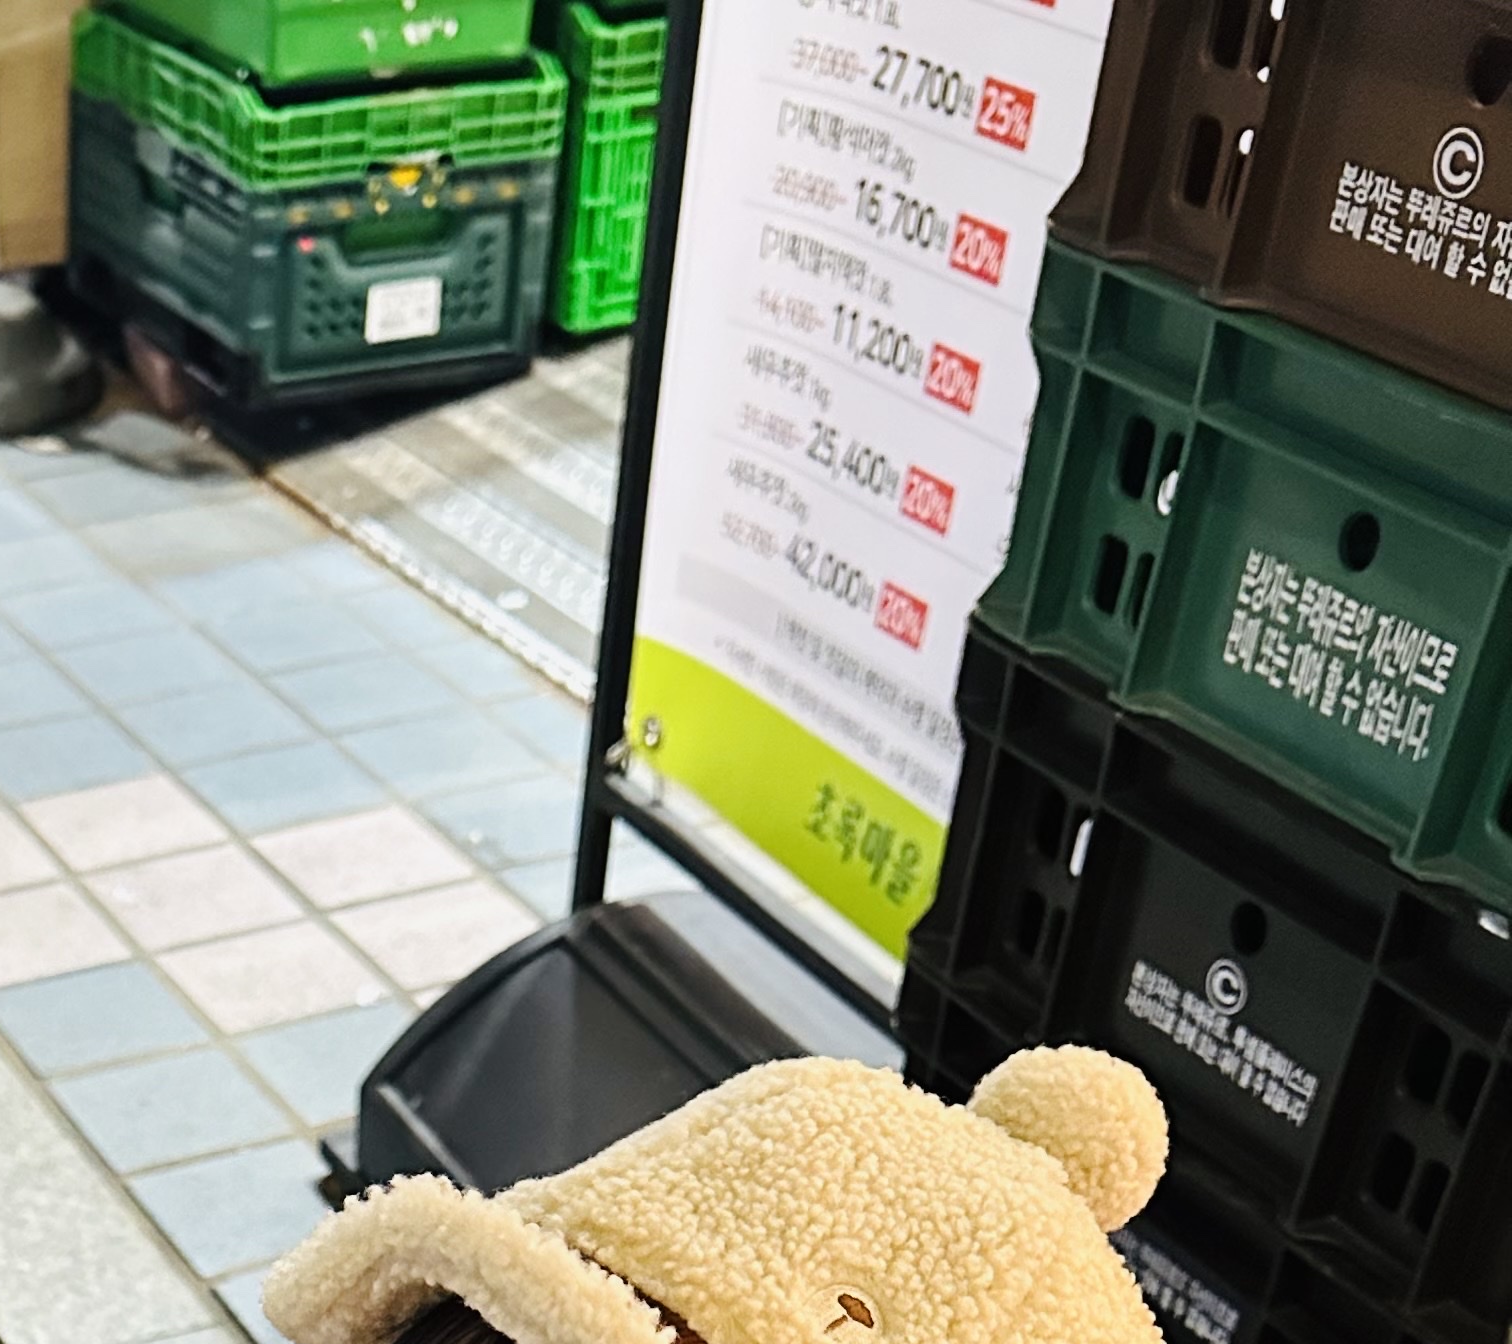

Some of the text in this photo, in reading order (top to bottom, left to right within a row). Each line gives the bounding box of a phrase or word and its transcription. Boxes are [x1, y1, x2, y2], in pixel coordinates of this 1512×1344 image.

[981, 85, 1031, 140] 25%
[1338, 161, 1404, 216] 본상자는
[1406, 188, 1491, 248] 뚜레쥬르의
[955, 220, 1006, 278] 20%
[1330, 198, 1368, 241] 판매
[1366, 213, 1403, 254] 또는
[1405, 228, 1444, 270] 대여
[1443, 241, 1465, 279] 할
[1467, 251, 1487, 286] 수
[929, 350, 976, 410] 20%
[905, 472, 951, 532] 20%
[877, 589, 925, 647] 20%
[1238, 548, 1458, 694] 본상자는 뚜레쥬르의 자산이므로
[1223, 609, 1262, 673] 판매
[1254, 626, 1292, 689] 또는
[1288, 644, 1327, 708] 대여
[1319, 656, 1345, 717] 할
[1341, 669, 1362, 726] 수
[802, 782, 921, 906] 초록마을
